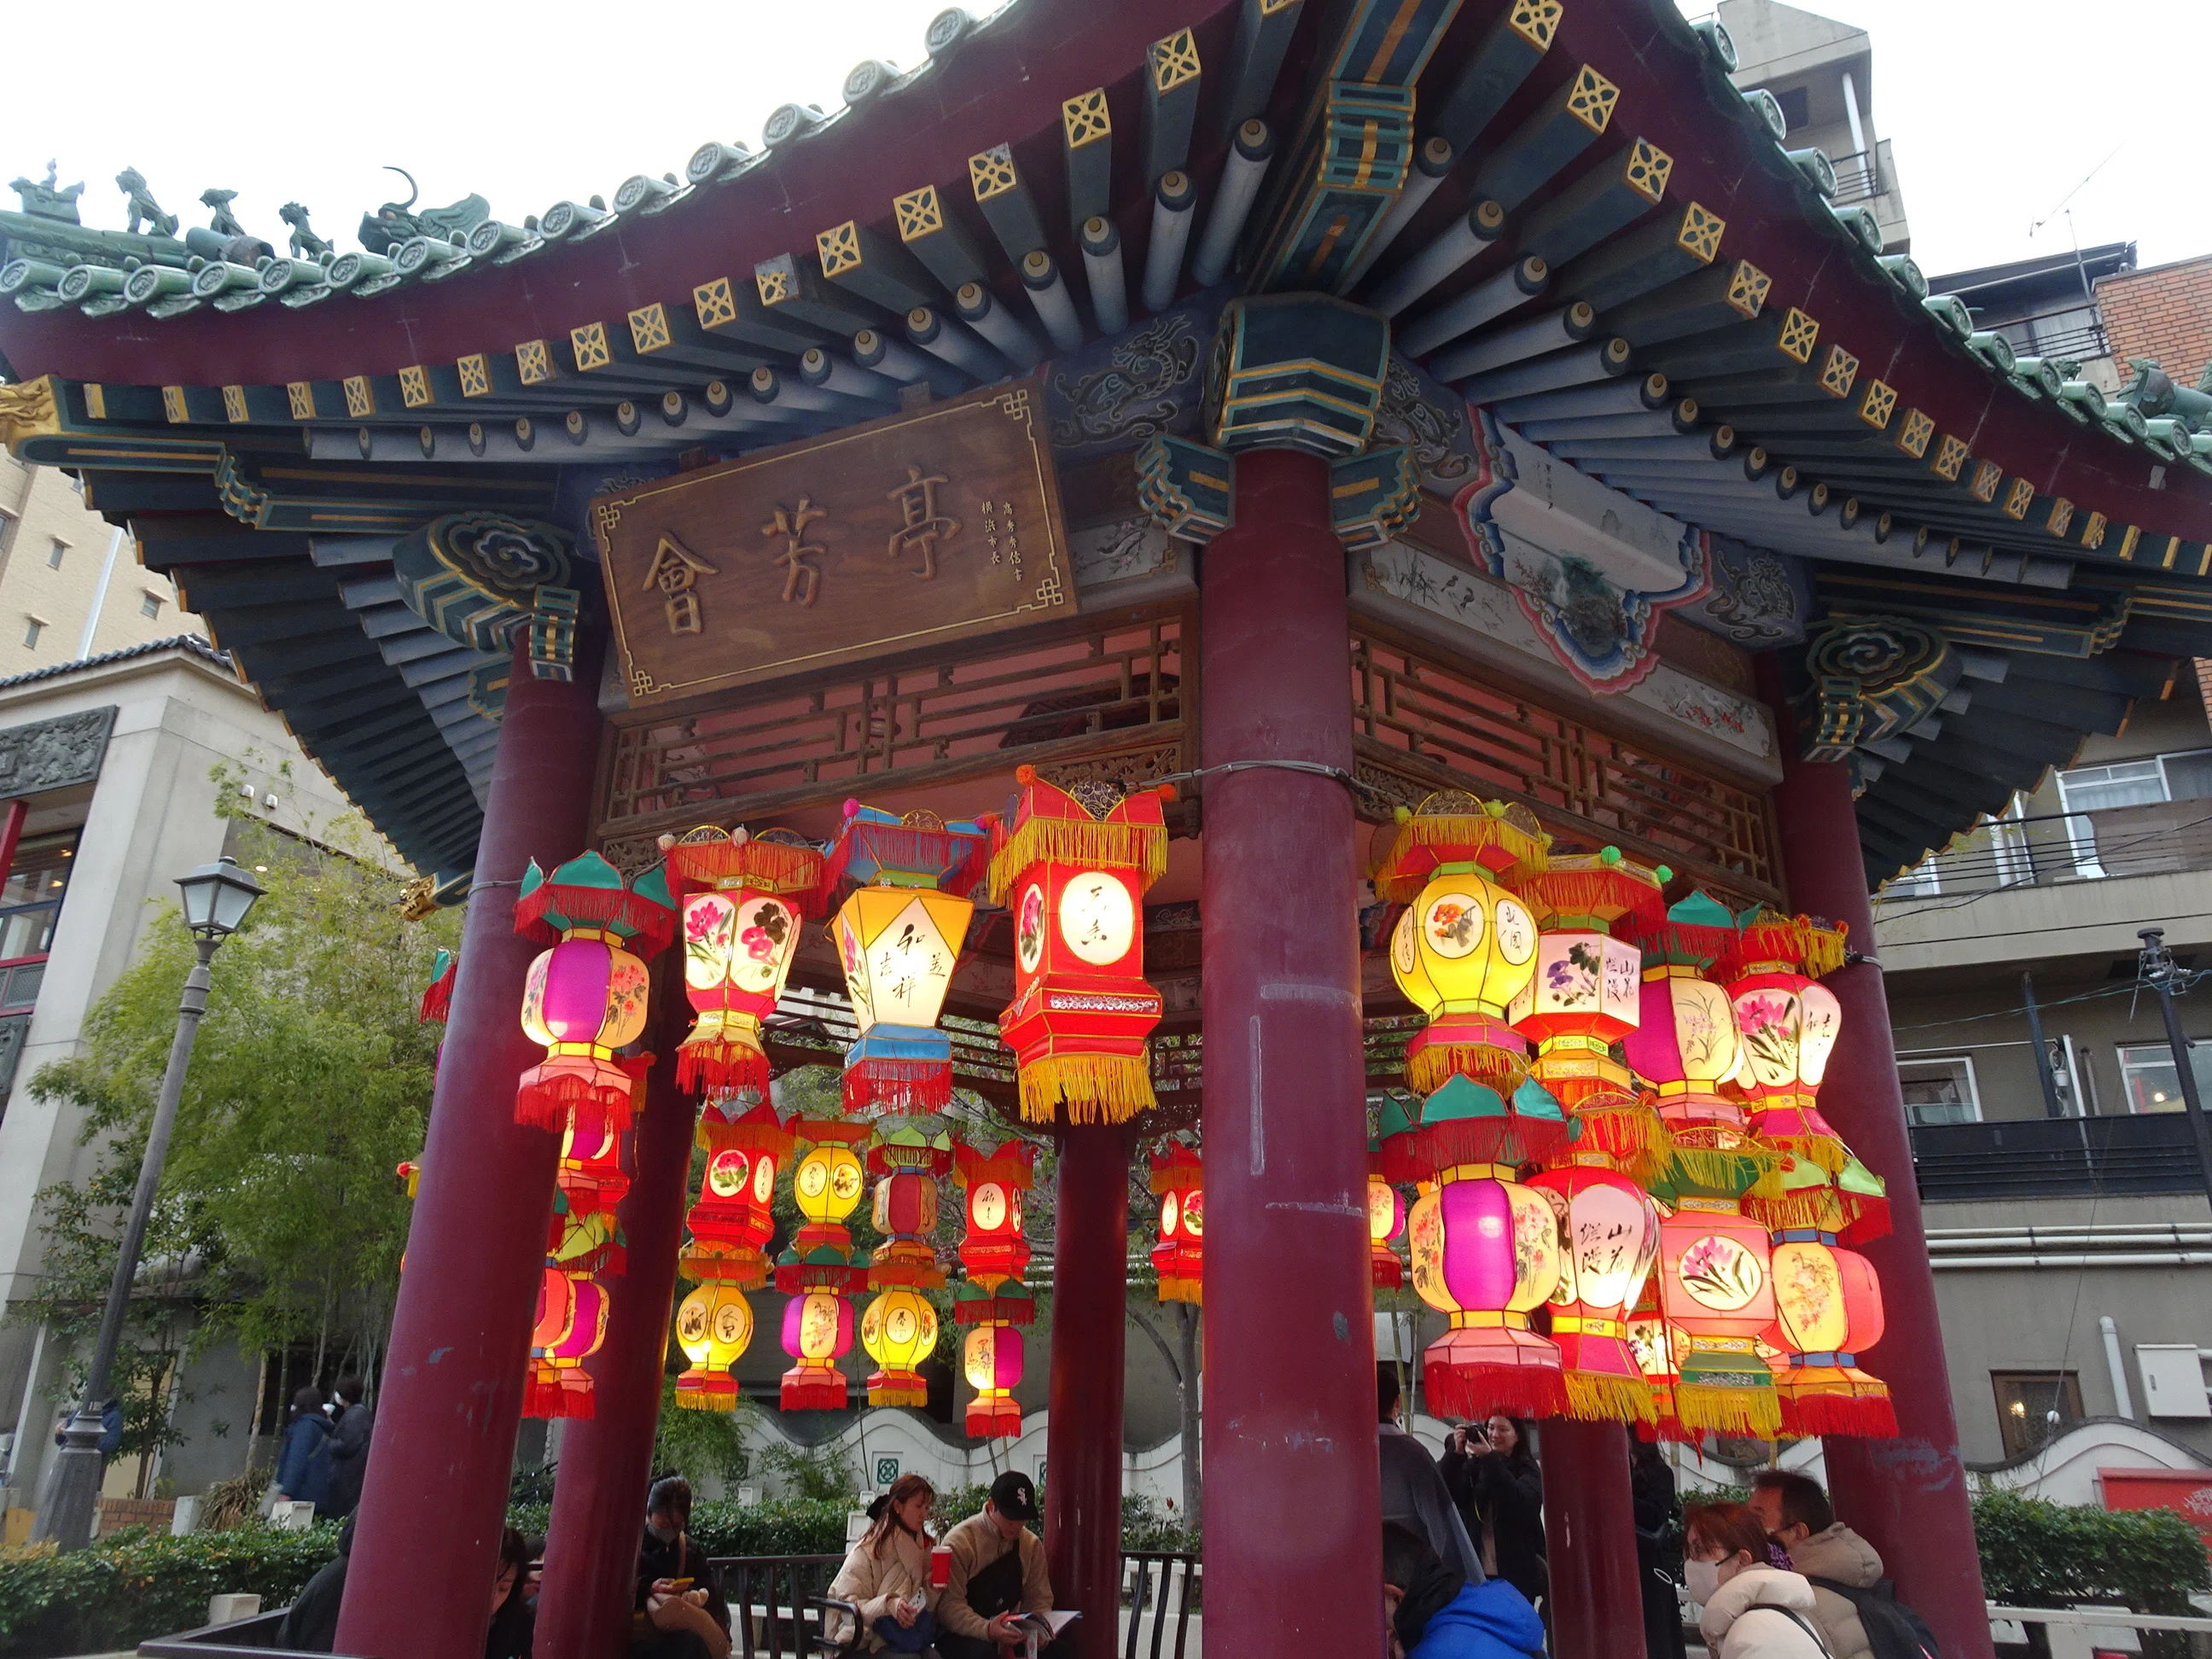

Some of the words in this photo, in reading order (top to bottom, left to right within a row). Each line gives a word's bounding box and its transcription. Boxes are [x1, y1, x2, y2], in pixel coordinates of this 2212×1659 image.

[642, 463, 963, 635] 會芳亭
[981, 500, 1001, 565] 横浜市長
